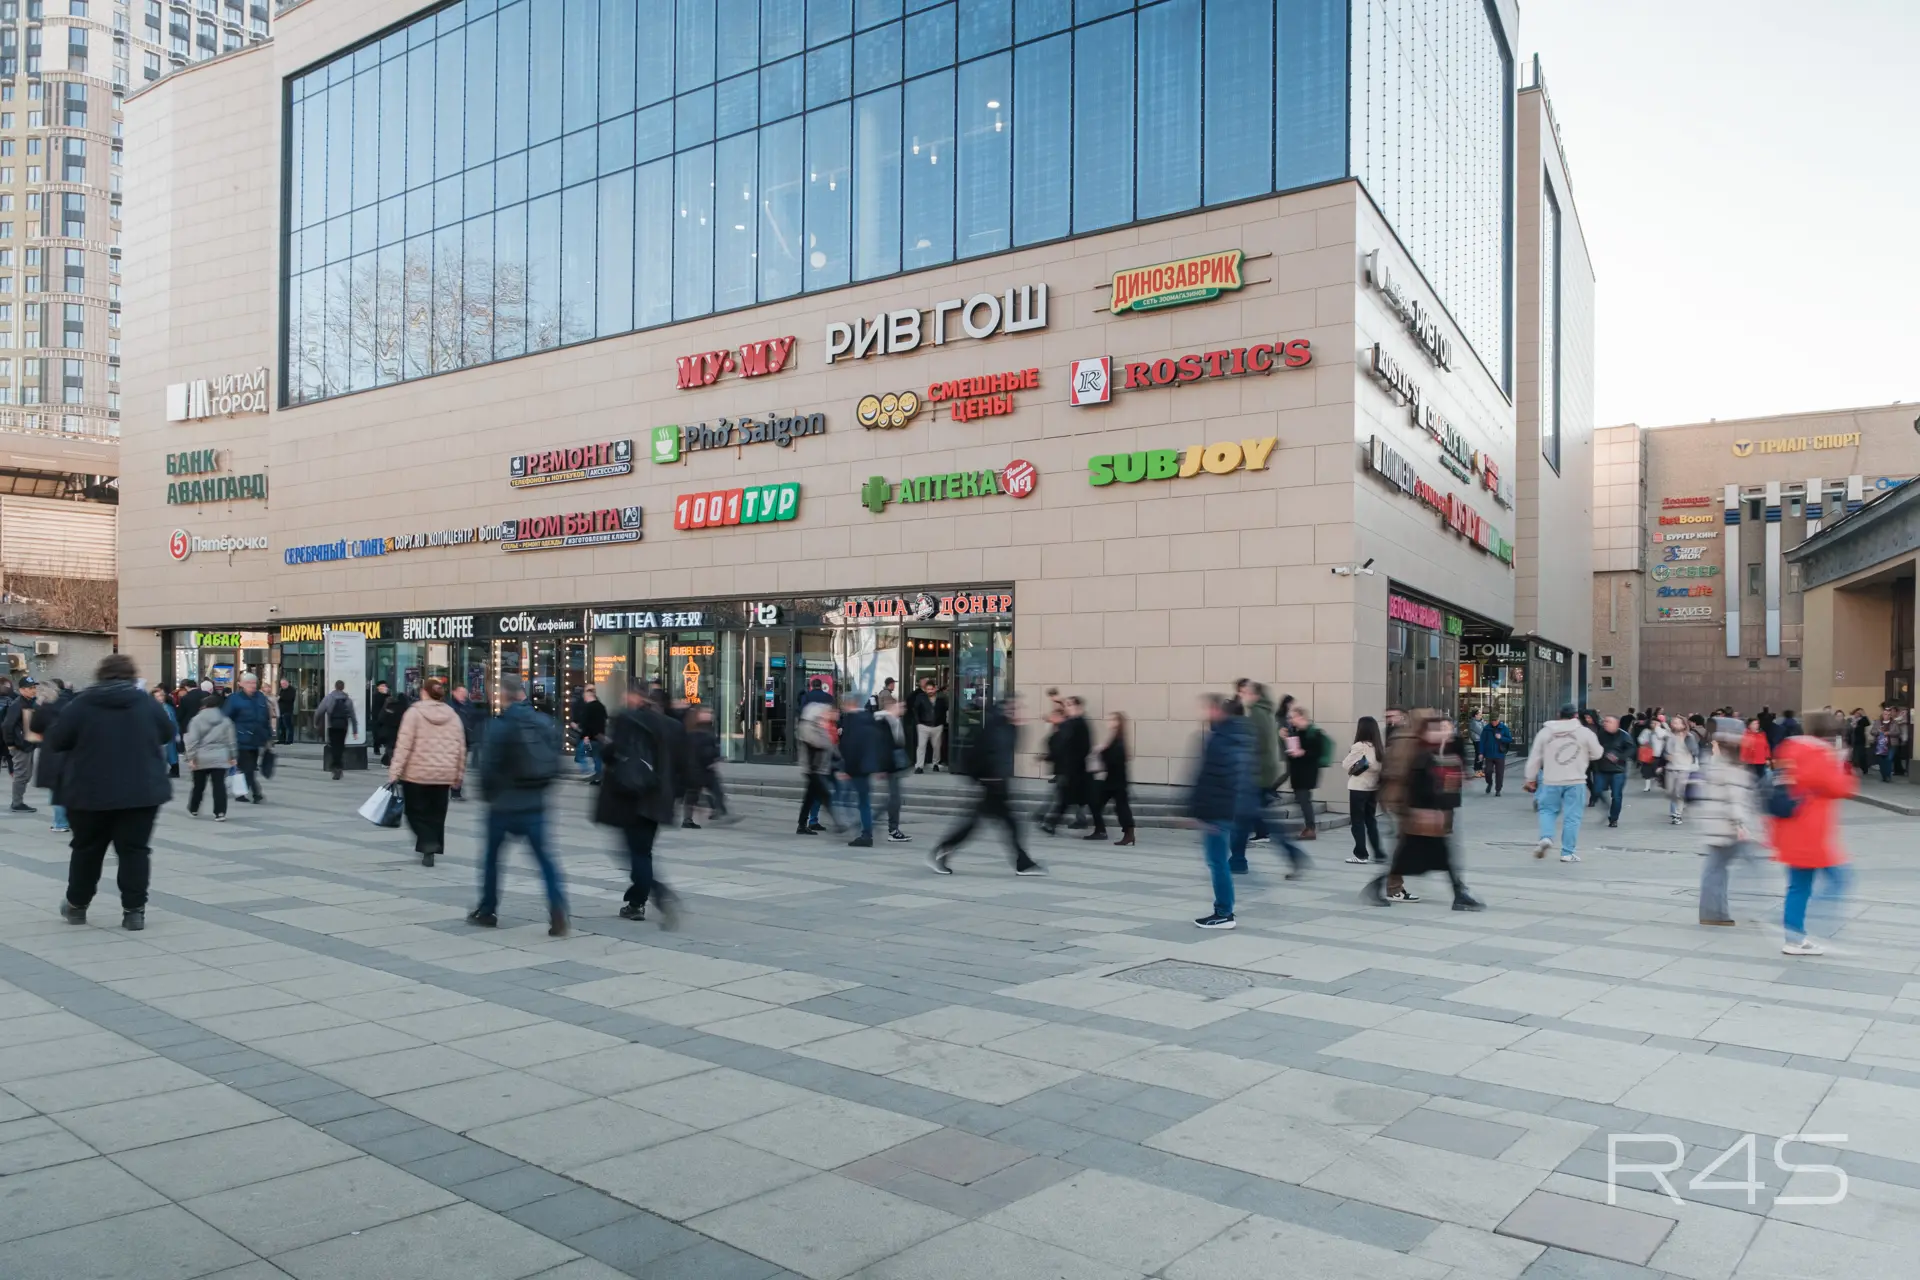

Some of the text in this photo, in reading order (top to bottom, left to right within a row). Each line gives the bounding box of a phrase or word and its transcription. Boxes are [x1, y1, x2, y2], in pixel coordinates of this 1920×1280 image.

[1113, 254, 1237, 308] ДИНОЗАВРИК
[1142, 297, 1158, 306] СЕТЬ
[825, 283, 1048, 364] РИВ ГОШ
[1124, 338, 1312, 389] ROSTIC'S
[212, 367, 267, 393] ЧИТАЙ
[927, 367, 1040, 402] СМЕШНЫЕ
[211, 390, 267, 415] ГОРОД
[951, 394, 1014, 423] ЦЕНЫ
[738, 411, 826, 448] Saigon
[166, 449, 217, 476] БАНК
[526, 441, 612, 475] РЕМОНТ
[590, 465, 628, 476] АКСЕССУАРЫ
[166, 473, 268, 504] АВАНГАРД
[898, 468, 1000, 504] АПТЕКА
[518, 508, 620, 540] ДОМ БЫТА
[1666, 531, 1718, 541] БУРГЕР КИНГ
[191, 534, 268, 553] Пятёрочка
[394, 532, 426, 551] COPY.RU
[478, 524, 501, 542] ФОТО
[567, 534, 611, 544] ИЗГОТОВЛЕНИЕ
[284, 538, 346, 565] СЕРЕБРЯНЫЙ
[594, 611, 702, 630] MET TEA 茶无双
[844, 599, 908, 618] ПАША
[280, 623, 323, 643] ШАУРМА
[410, 617, 437, 639] PRICE
[438, 616, 474, 638] COFFEE
[500, 612, 536, 632] cofix
[537, 618, 574, 633] кофейня
[195, 631, 241, 647] ТАБАК
[671, 645, 701, 656] BUBBLE
[1472, 643, 1510, 656] ГОШ
